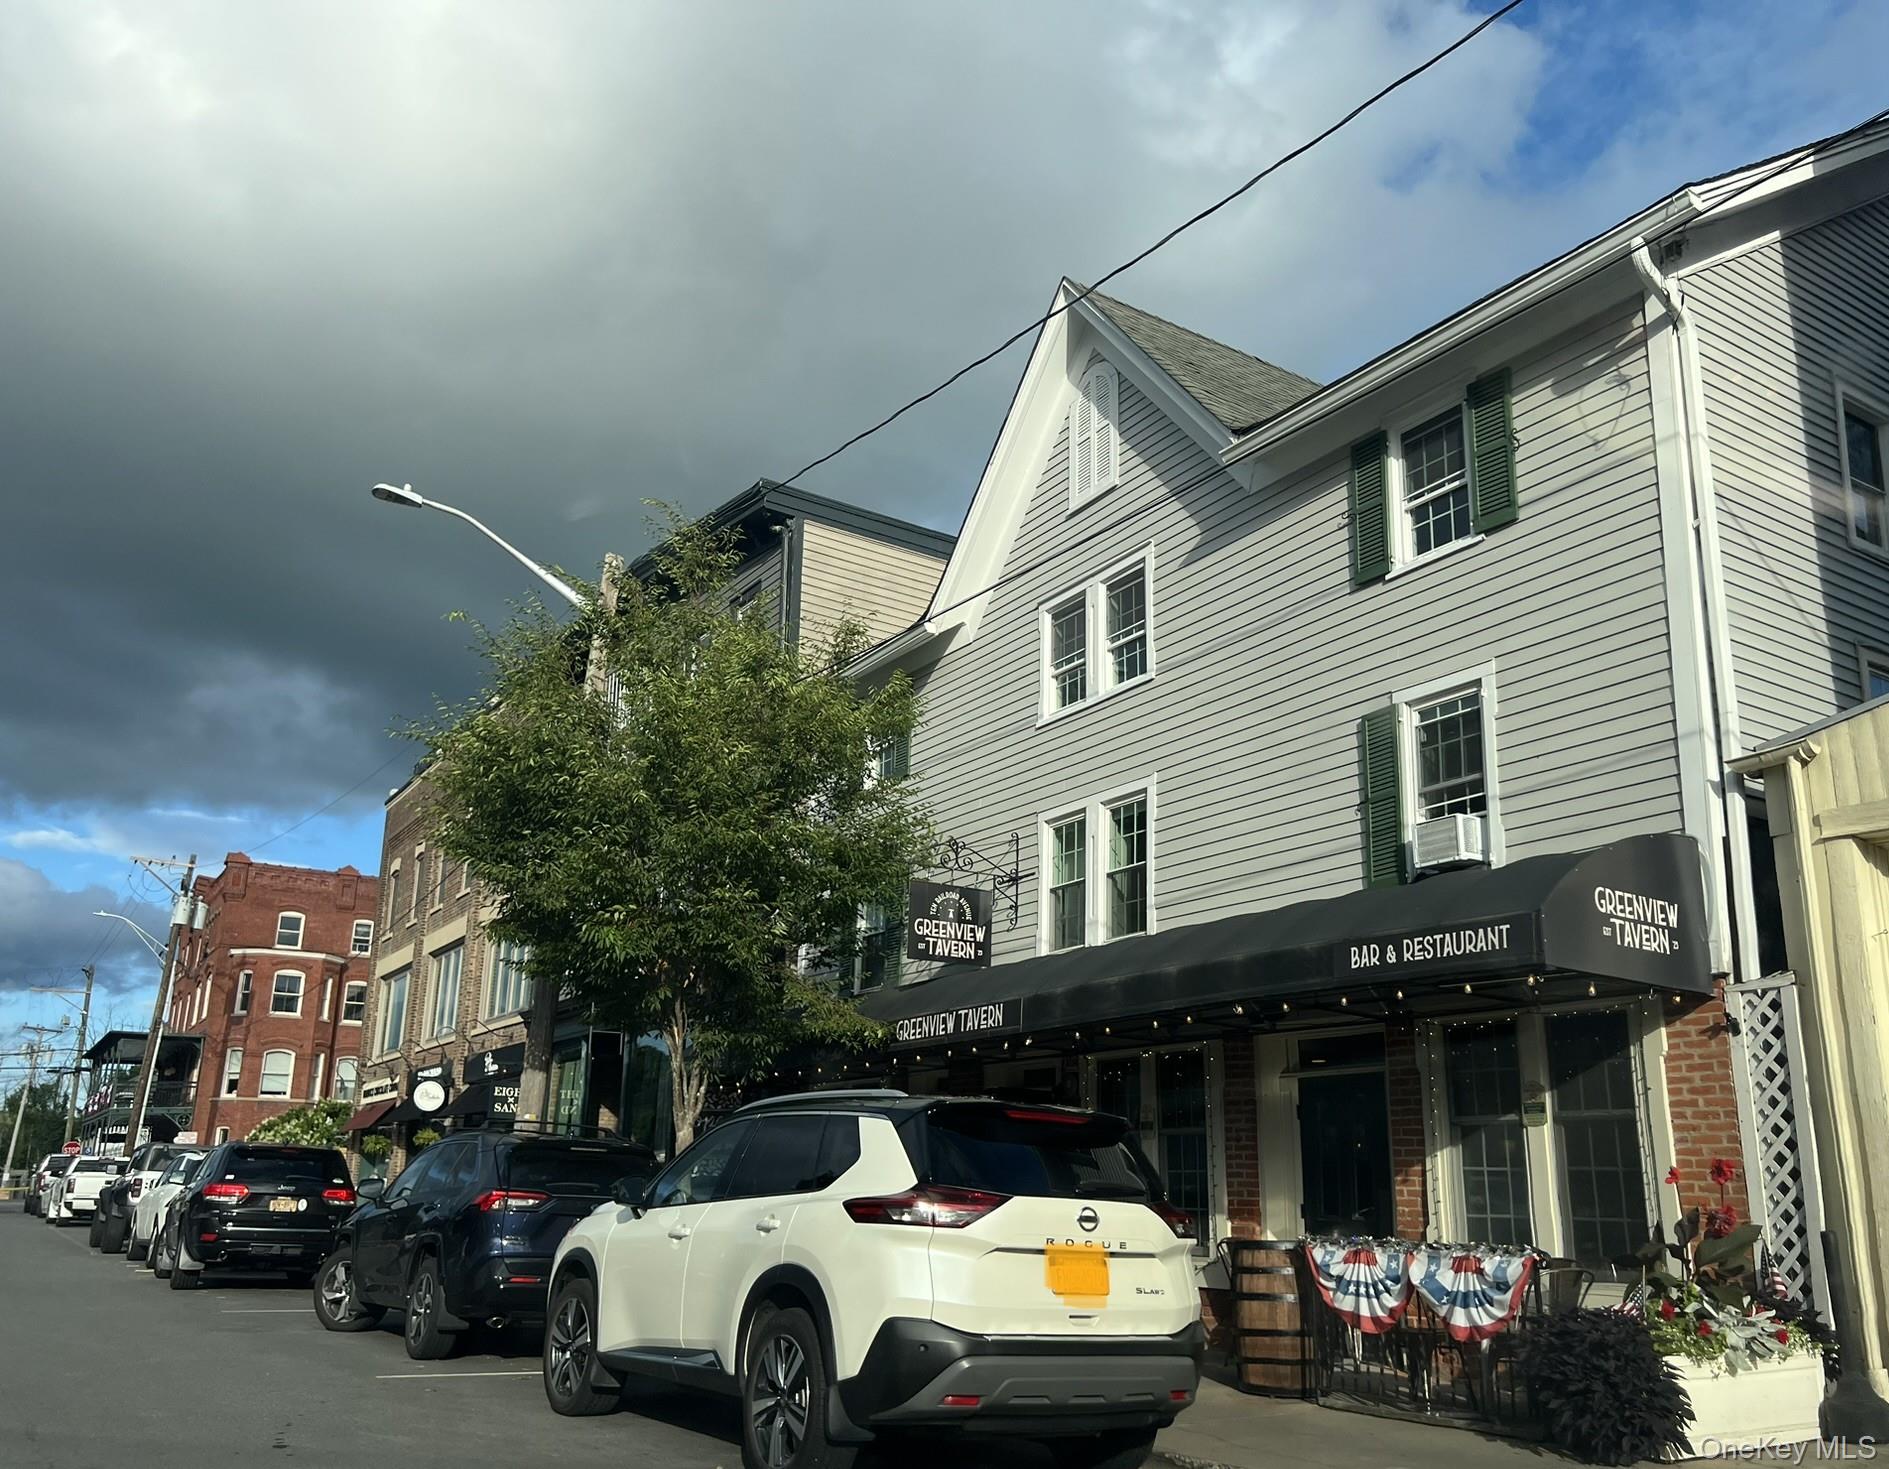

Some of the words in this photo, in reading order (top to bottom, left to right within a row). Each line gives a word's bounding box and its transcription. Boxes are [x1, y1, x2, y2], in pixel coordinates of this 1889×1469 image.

[930, 902, 938, 915] TEN
[959, 897, 973, 921] AVENUE
[1594, 886, 1678, 928] GREENVIEW
[914, 918, 986, 943] GREENVIEW
[1610, 918, 1671, 955] TAVERN
[925, 937, 976, 960] TAVERN
[1350, 944, 1380, 969] BAR
[1386, 943, 1397, 964] &
[1403, 924, 1510, 962] RESTAURANT
[896, 1010, 957, 1042] GREENVIEW
[957, 1003, 1004, 1032] TAVERN
[494, 1086, 520, 1097] EIGH
[1046, 1238, 1127, 1249] ROGUE
